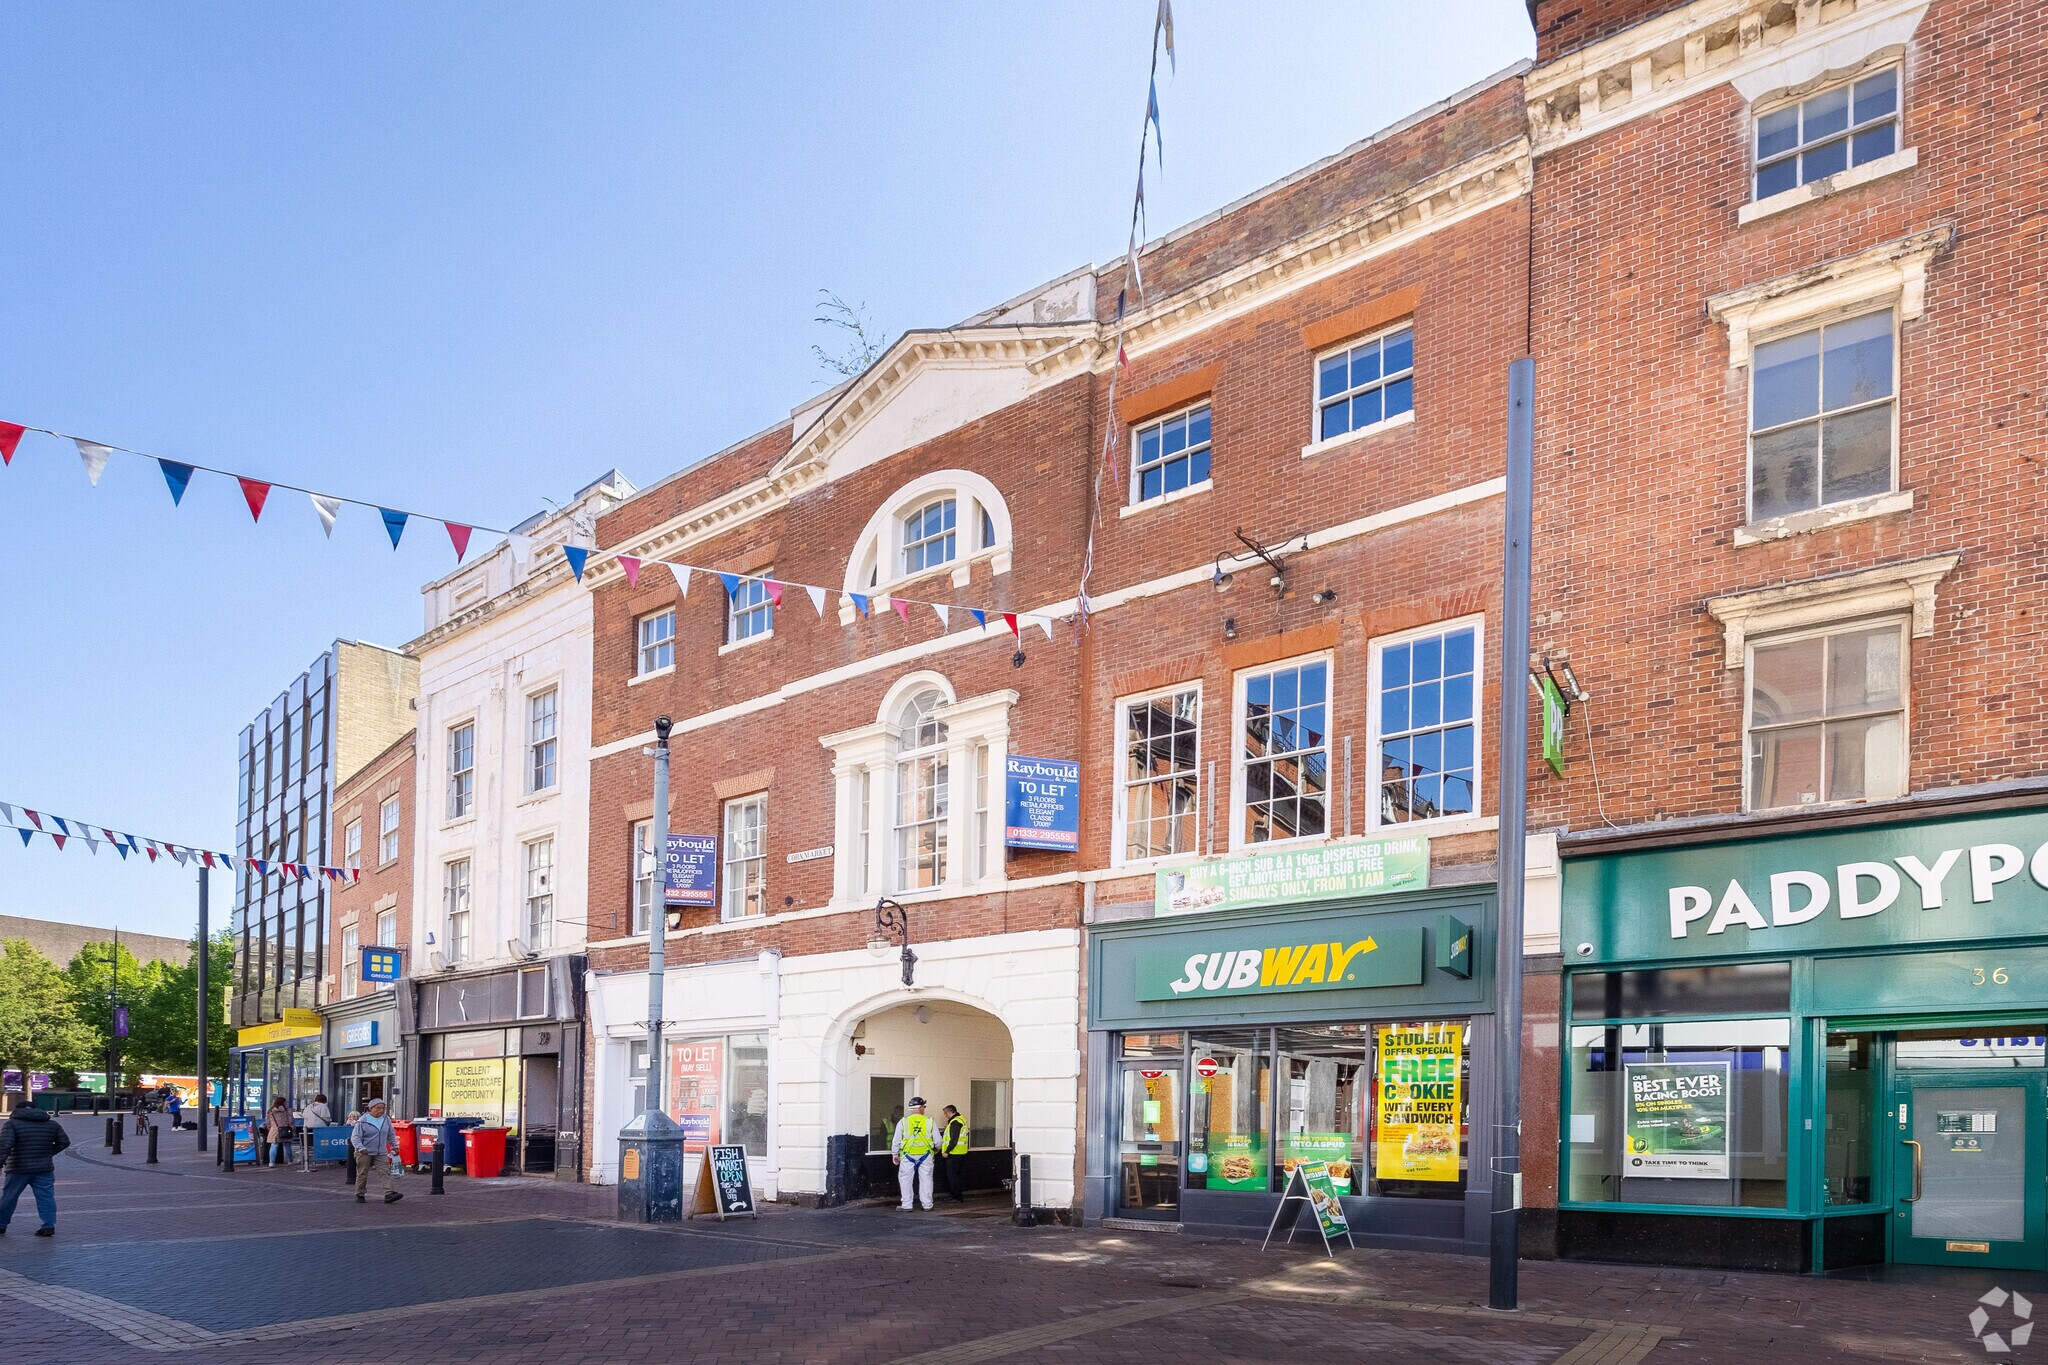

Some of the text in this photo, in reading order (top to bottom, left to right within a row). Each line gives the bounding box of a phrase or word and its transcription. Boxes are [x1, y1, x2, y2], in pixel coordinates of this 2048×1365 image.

[1008, 760, 1078, 778] Raybould
[1019, 782, 1066, 796] TO LET
[1020, 801, 1064, 810] RETAIL/OFFICES
[1030, 814, 1054, 822] CLASSIC
[1013, 829, 1070, 840] 01332 295555
[667, 839, 714, 850] aybould
[683, 854, 705, 863] LET
[788, 848, 832, 861] CORN MARKET
[1190, 838, 1421, 879] BUY A 6-INCH SUB & A 16oz DISPENSED DRINK,
[1229, 856, 1384, 888] GET ANOTHER 6-INCH SUB FREE
[1229, 871, 1384, 901] SUNDAYS ONLY, FROM 11AM
[1668, 843, 2048, 939] PADDYP
[1450, 934, 1468, 959] SUBWAY
[1170, 936, 1378, 996] SUBWAY
[1972, 966, 2008, 985] 36
[269, 1029, 280, 1040] Frank
[346, 1025, 370, 1044] GREGGS
[1385, 1032, 1455, 1046] STUDENT
[677, 1047, 717, 1062] TO LET
[1385, 1046, 1454, 1056] OFFER SPECIAL
[456, 1066, 491, 1075] EXCELLENT
[1385, 1058, 1454, 1083] FREE
[446, 1078, 501, 1088] RESTAURANT/CAFE
[1633, 1075, 1722, 1093] BEST EVER
[452, 1090, 494, 1100] OPPORTUNITY
[1634, 1087, 1722, 1102] RACING BOOST
[1384, 1102, 1454, 1112] WITH EVERY
[680, 1118, 709, 1127] Raybould
[1384, 1113, 1453, 1125] SANDWICH
[714, 1148, 738, 1160] FISH
[715, 1159, 743, 1171] MARKET
[720, 1171, 743, 1182] OPEN
